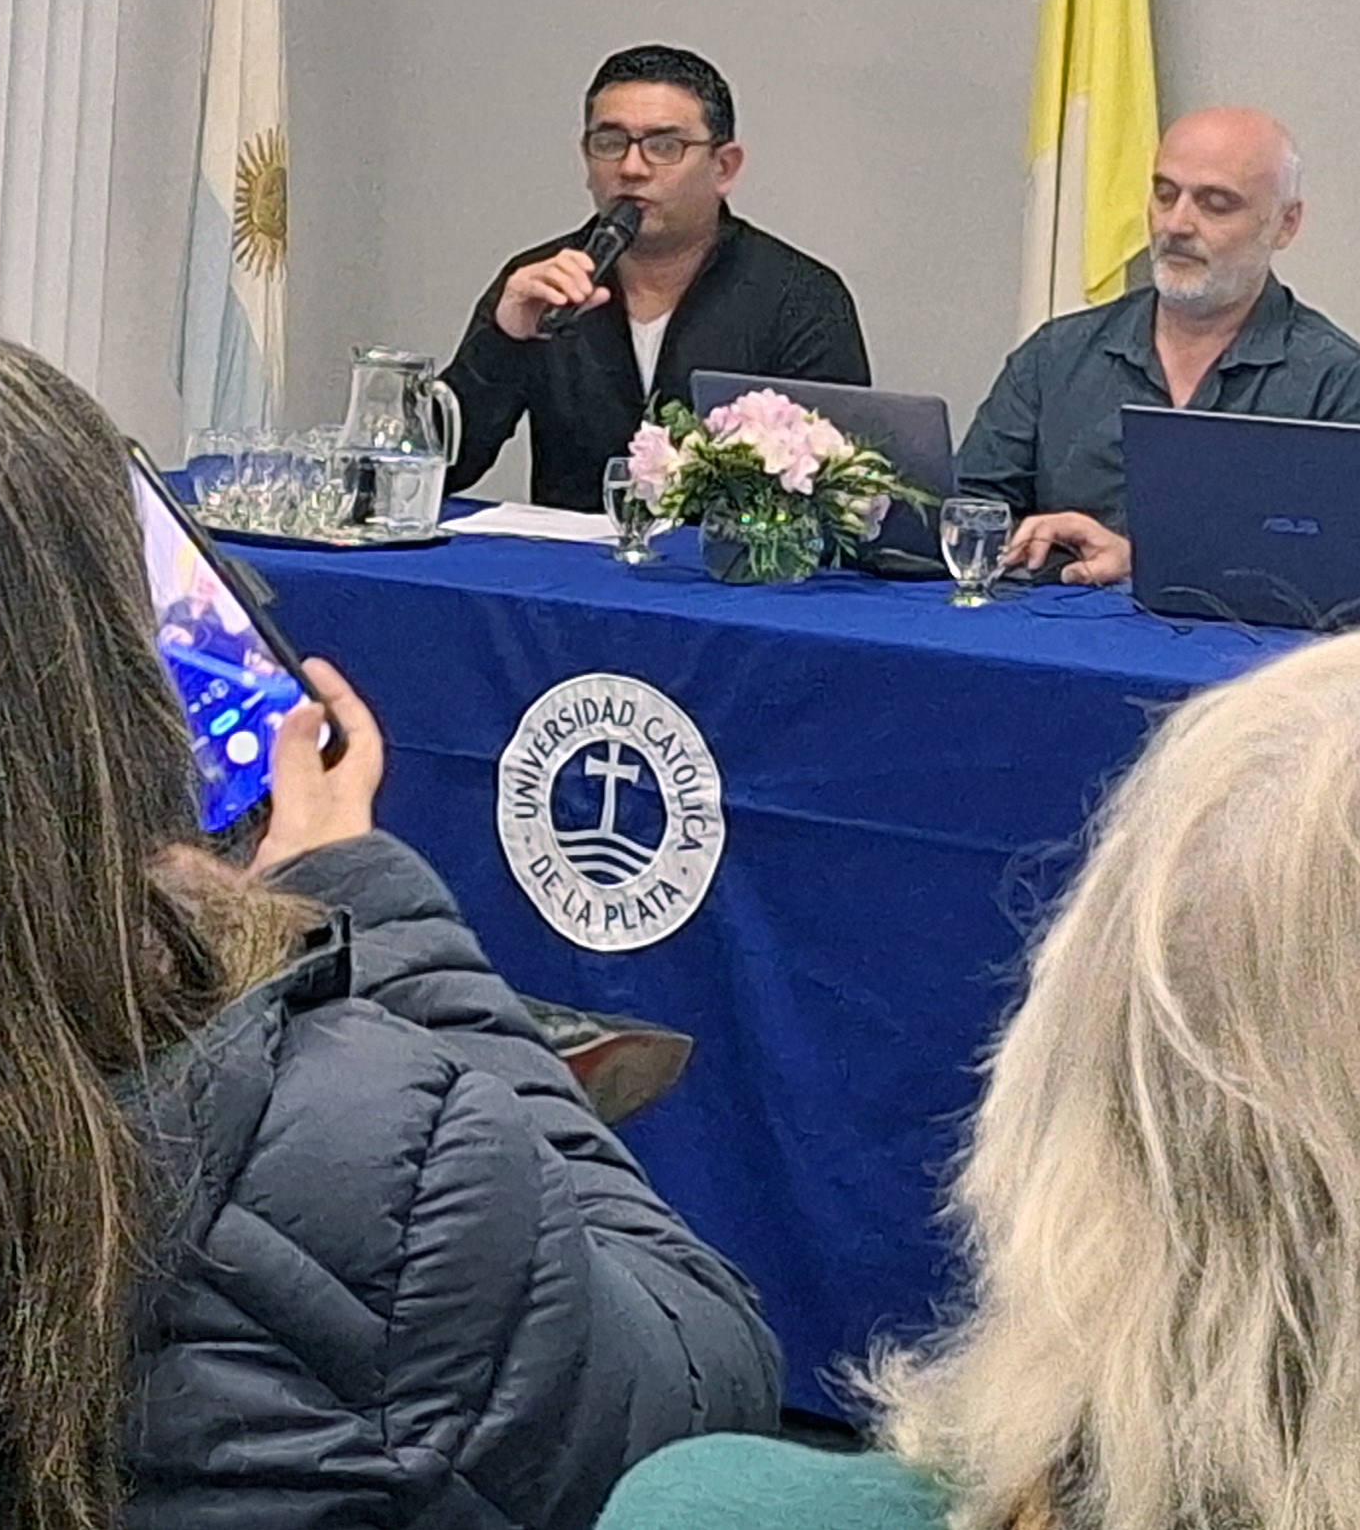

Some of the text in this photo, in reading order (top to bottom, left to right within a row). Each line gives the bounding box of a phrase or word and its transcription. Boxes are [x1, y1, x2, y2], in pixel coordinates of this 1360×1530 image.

[515, 696, 707, 851] UNIVERSIDAD CATOLICA
[530, 854, 683, 932] DE LA PLATA
